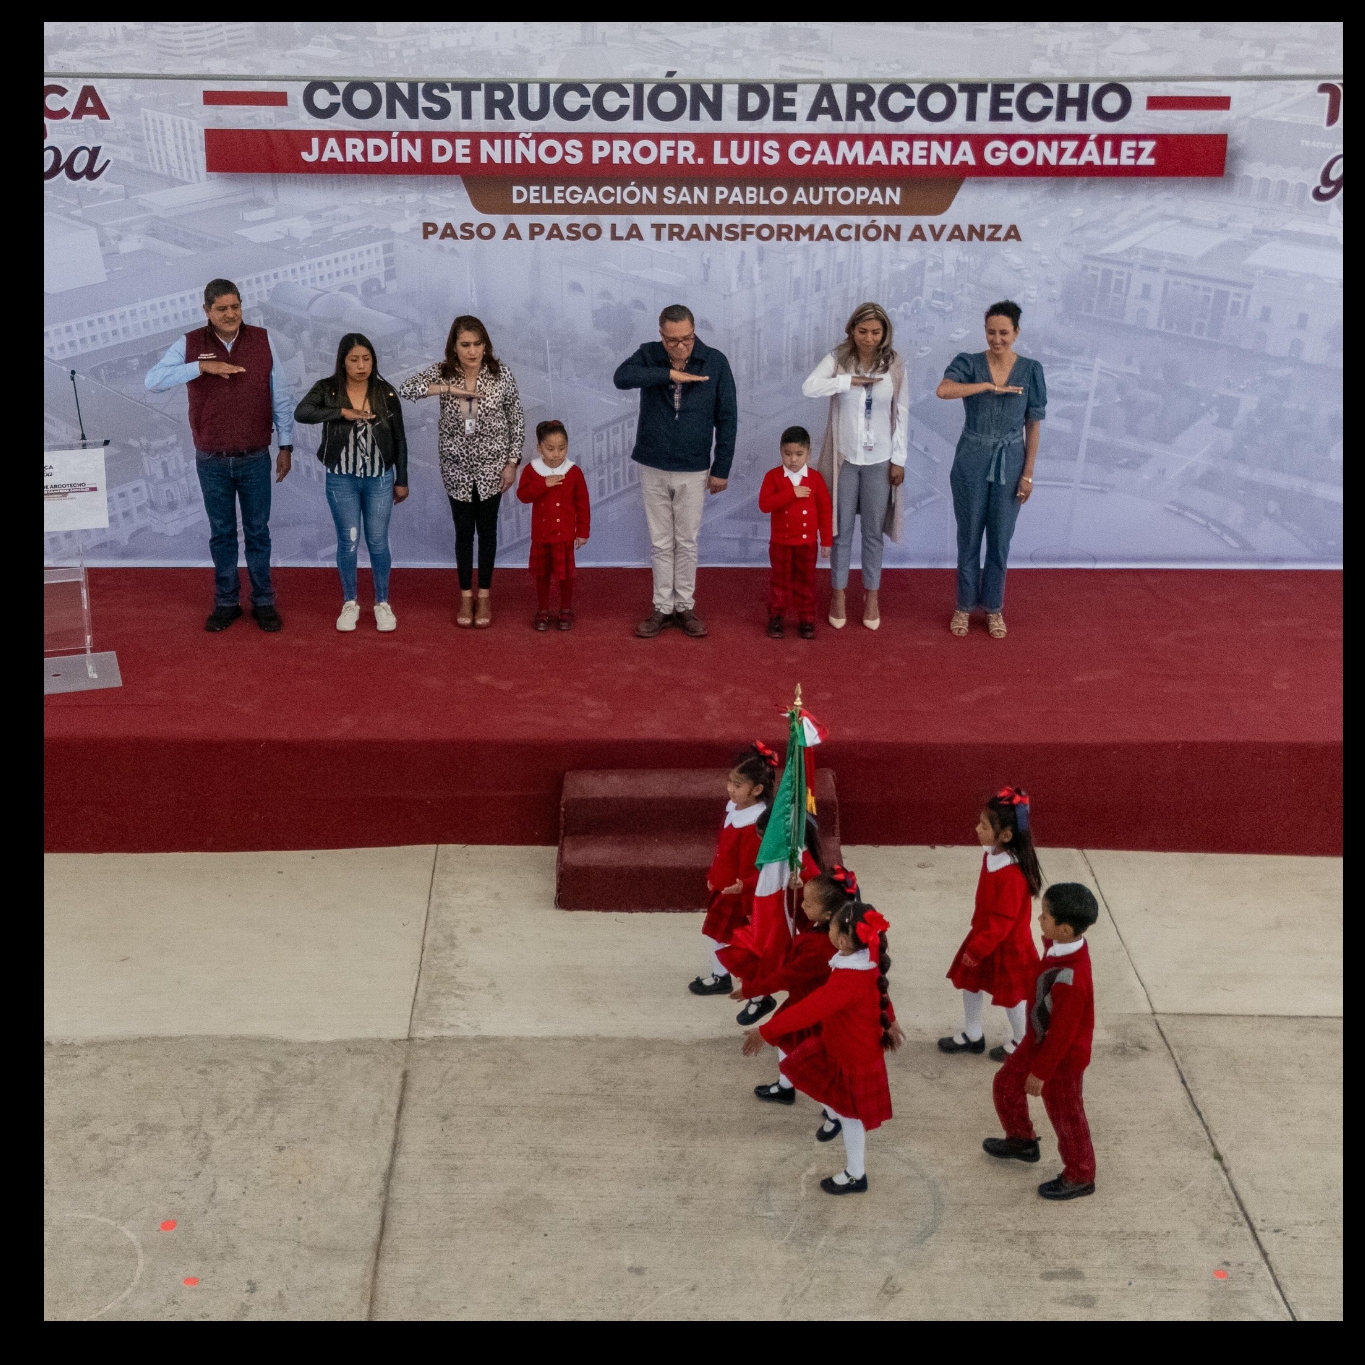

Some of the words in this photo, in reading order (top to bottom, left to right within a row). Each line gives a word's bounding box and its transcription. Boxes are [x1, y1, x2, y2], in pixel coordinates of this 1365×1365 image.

[302, 71, 723, 122] CONSTRUCCIÓN
[738, 83, 797, 122] DE
[805, 82, 1132, 123] ARCOTECHO
[300, 132, 421, 164] JARDÍN
[432, 139, 471, 164] DE
[480, 133, 583, 165] NIÑOS
[592, 140, 704, 166] PROFR.
[714, 140, 780, 166] LUIS
[787, 140, 976, 167] CAMARENA
[984, 135, 1156, 167] GONZÁLEZ
[512, 182, 657, 205] DELEGACIÓN
[663, 186, 708, 206] SAN
[715, 186, 787, 206] PABLO
[792, 186, 901, 206] AUTOPAN
[422, 222, 496, 241] PASO
[502, 223, 523, 241] A
[529, 223, 601, 242] PASO
[610, 224, 645, 242] LA
[651, 219, 901, 243] TRANSFORMACIÓN
[907, 224, 1022, 243] AVANZA
